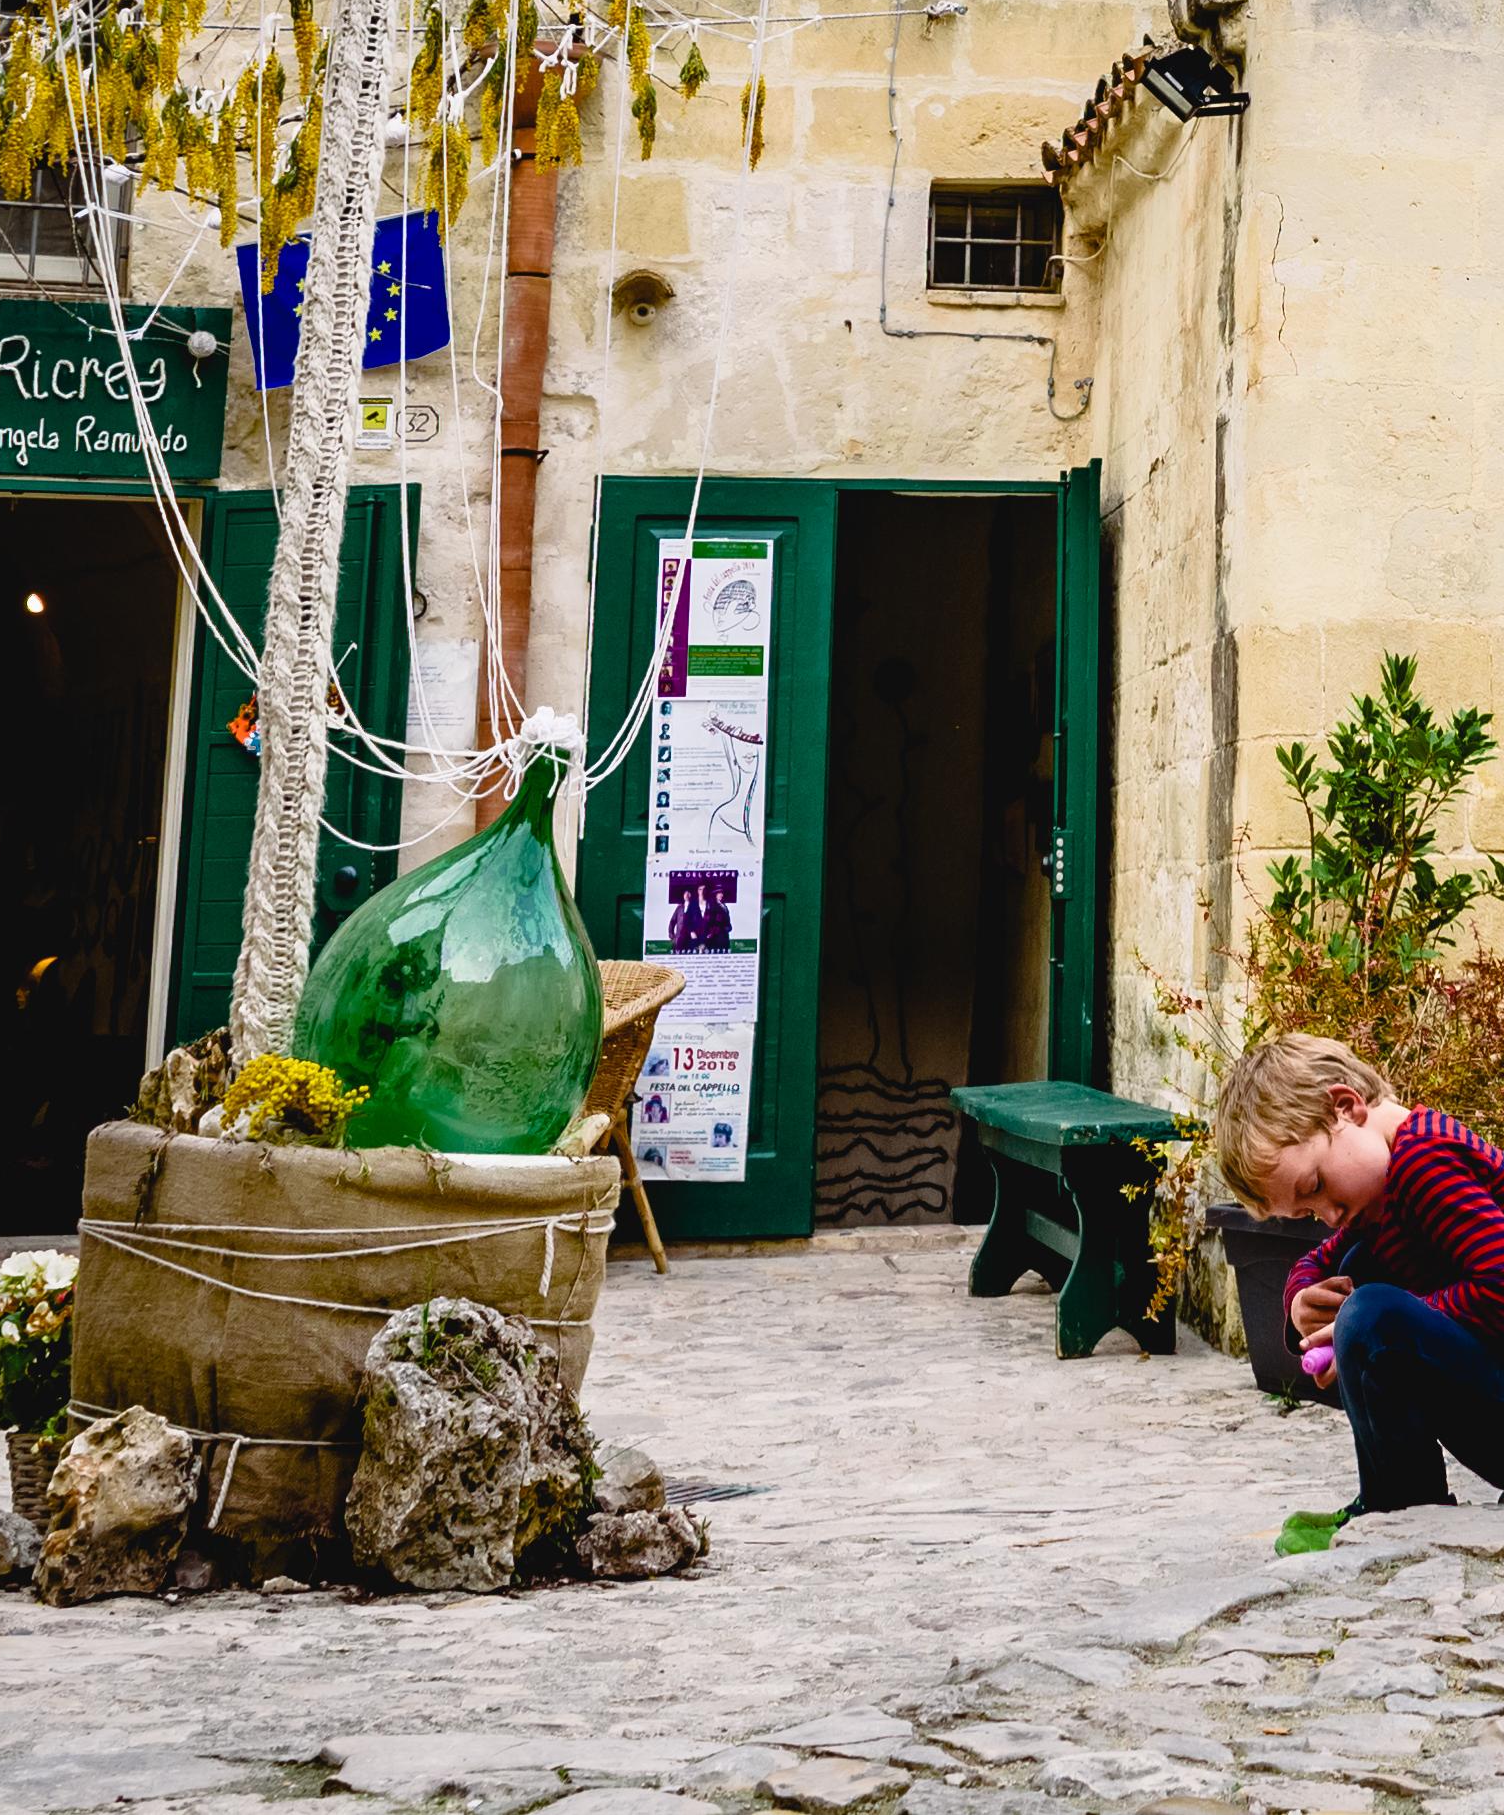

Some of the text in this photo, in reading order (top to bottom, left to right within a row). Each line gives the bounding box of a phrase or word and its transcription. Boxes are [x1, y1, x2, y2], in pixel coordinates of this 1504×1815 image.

[405, 412, 430, 434] 32
[673, 1047, 740, 1071] 13 Dicembre
[697, 1061, 737, 1071] 2015
[649, 1082, 740, 1093] FESTA DEL CAPPELLO
